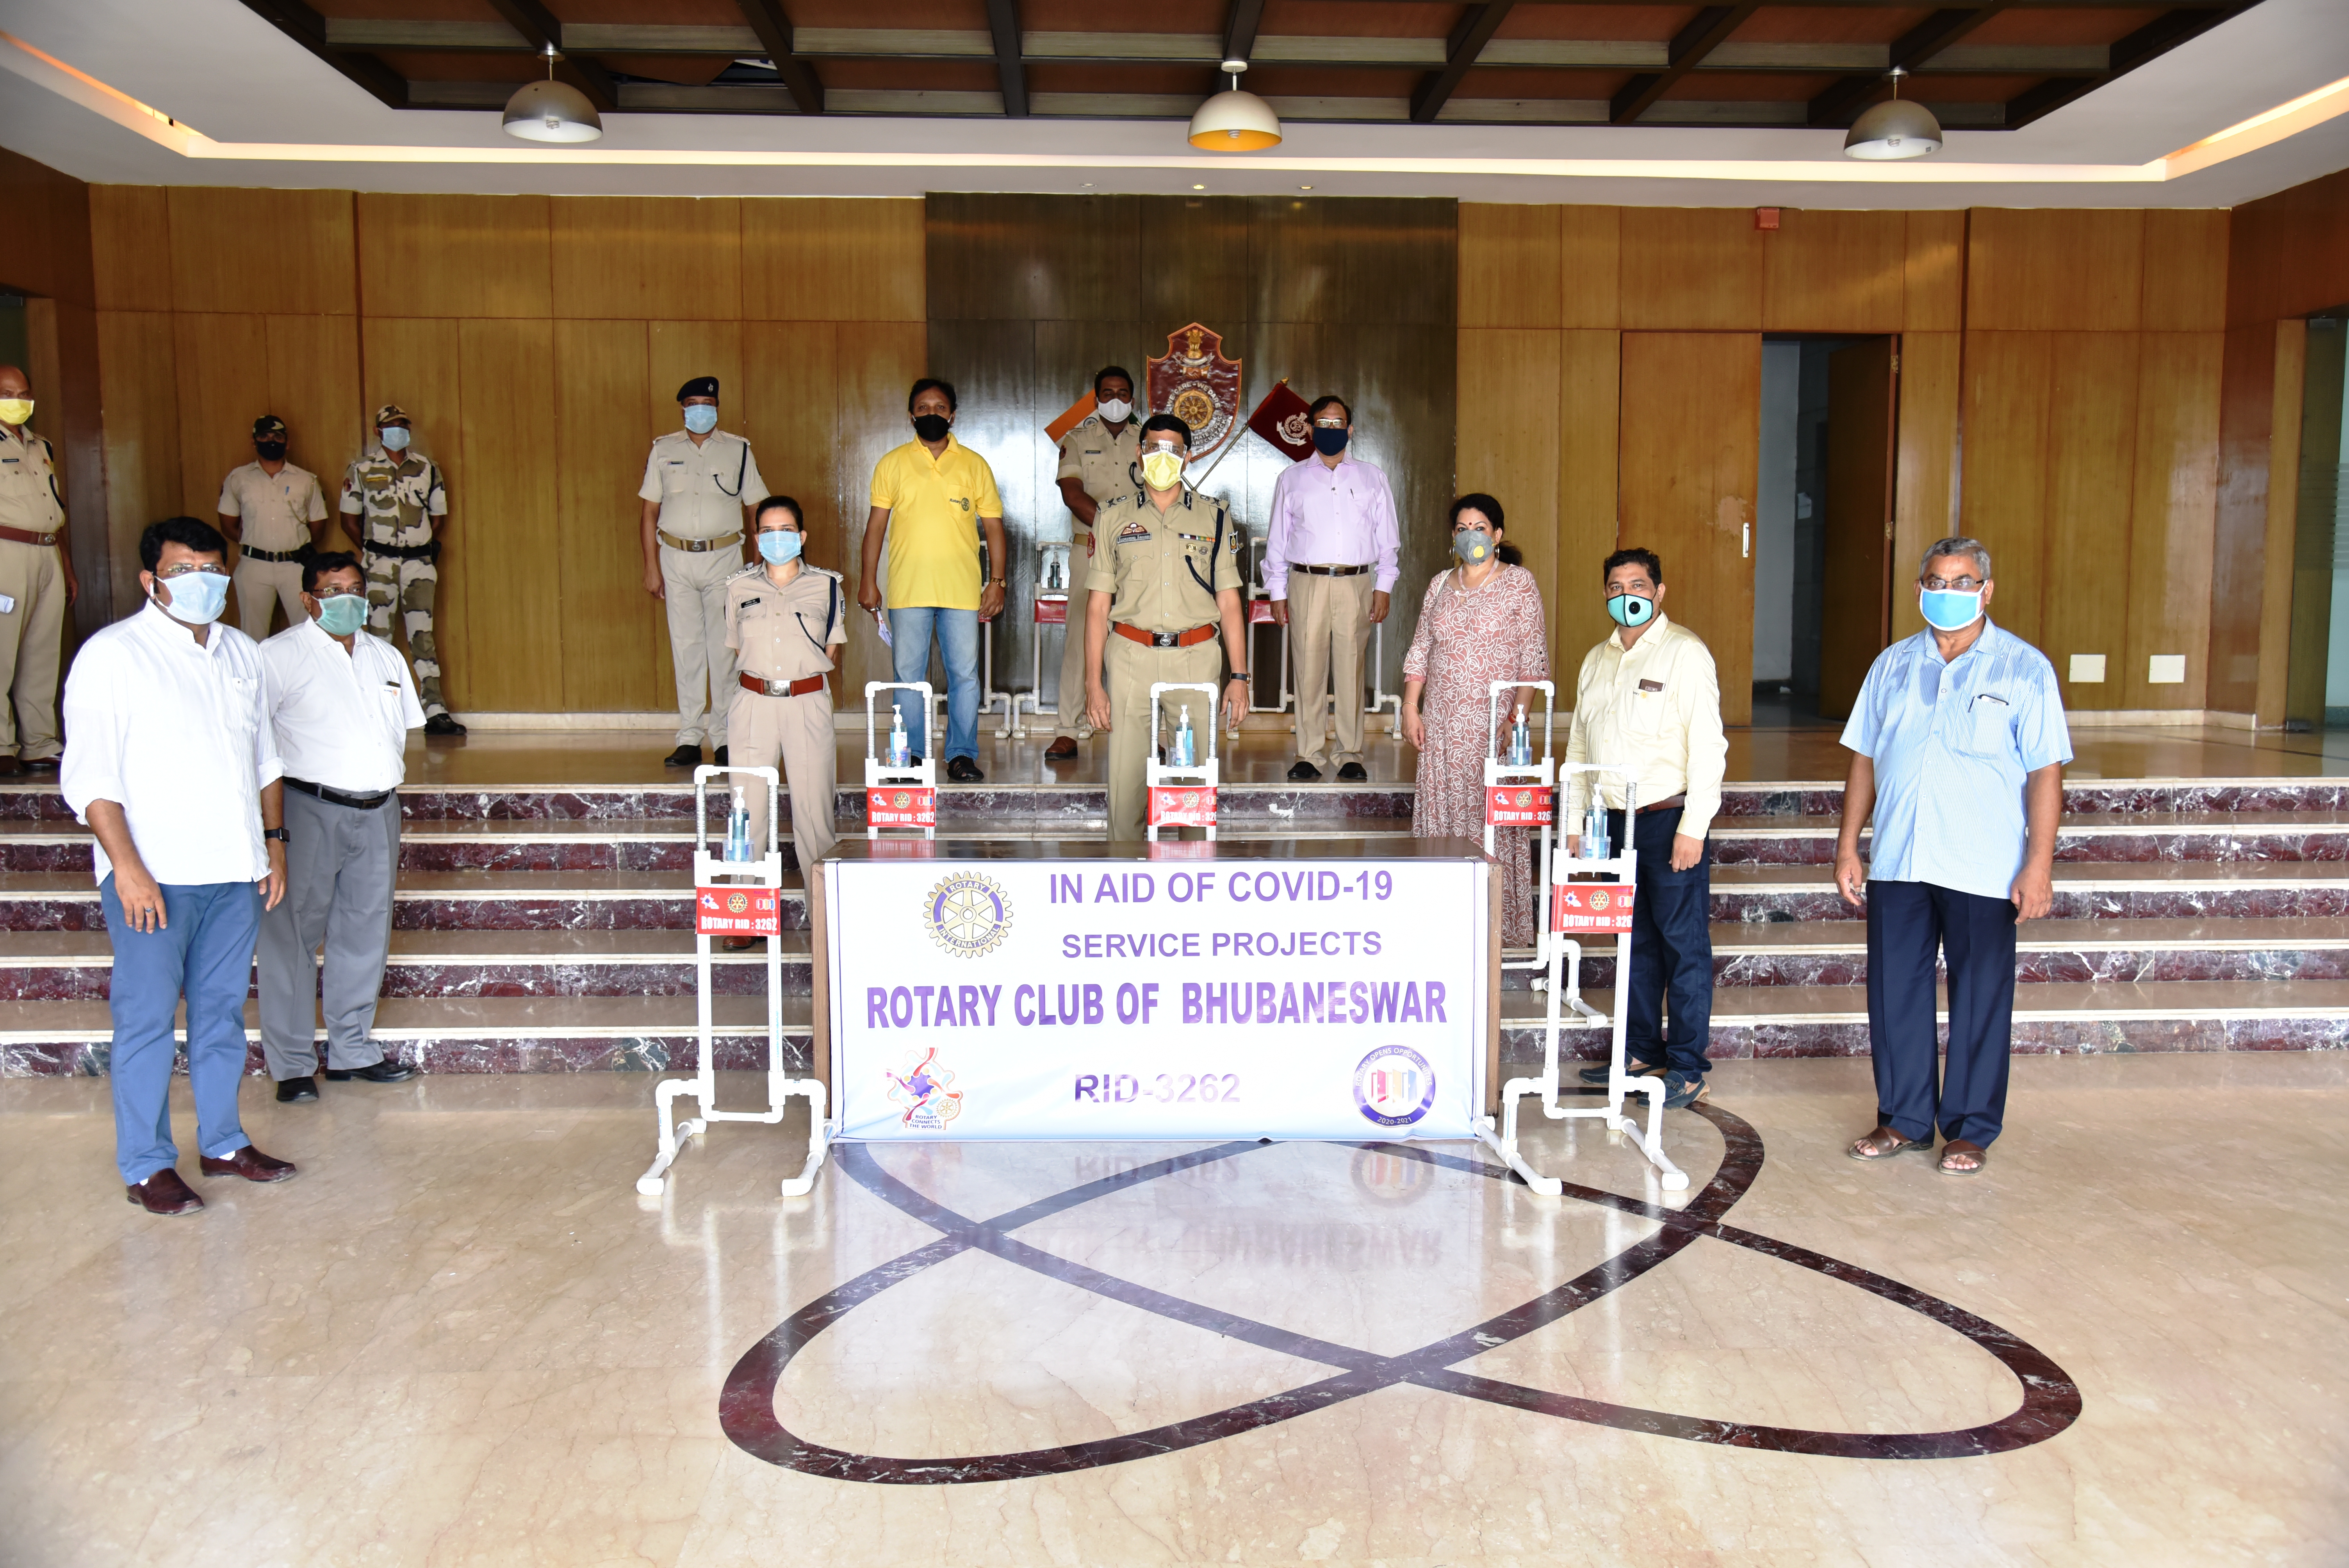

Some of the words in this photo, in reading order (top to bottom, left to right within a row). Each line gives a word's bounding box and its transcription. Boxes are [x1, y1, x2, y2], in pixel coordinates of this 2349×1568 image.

[1166, 394, 1175, 406] WE
[1174, 382, 1192, 394] CARE
[1197, 382, 1209, 392] WE
[1207, 389, 1221, 408] DARE
[1211, 412, 1223, 432] POLICE
[872, 811, 899, 823] ROTARY
[900, 813, 912, 821] RID
[916, 811, 934, 823] 3262
[1494, 810, 1520, 821] ROTARY
[1521, 812, 1533, 820] RID
[949, 881, 986, 892] ROTARY
[1051, 874, 1082, 903] IN
[1095, 873, 1154, 903] AID
[1168, 872, 1215, 903] OF
[1229, 870, 1392, 902] COVID-19
[701, 916, 733, 930] ROTARY
[735, 919, 750, 929] RID
[755, 917, 777, 931] 3262
[1563, 914, 1595, 927] ROTARY
[1596, 916, 1611, 927] RID
[939, 927, 1000, 948] INTERNATIONAL
[1062, 933, 1200, 958] SERVICE
[1213, 931, 1381, 956] PROJECTS
[868, 985, 1002, 1028] ROTARY
[1014, 984, 1104, 1026] CLUB
[1116, 982, 1159, 1025] OF
[1183, 981, 1447, 1024] BHUBANESWAR
[1356, 1058, 1370, 1087] ROTARY
[1370, 1048, 1392, 1060] OPENS
[1394, 1048, 1432, 1086] OPPORTUNITIES
[1075, 1073, 1240, 1102] RID-3262
[1377, 1116, 1412, 1125] 2020-2021
